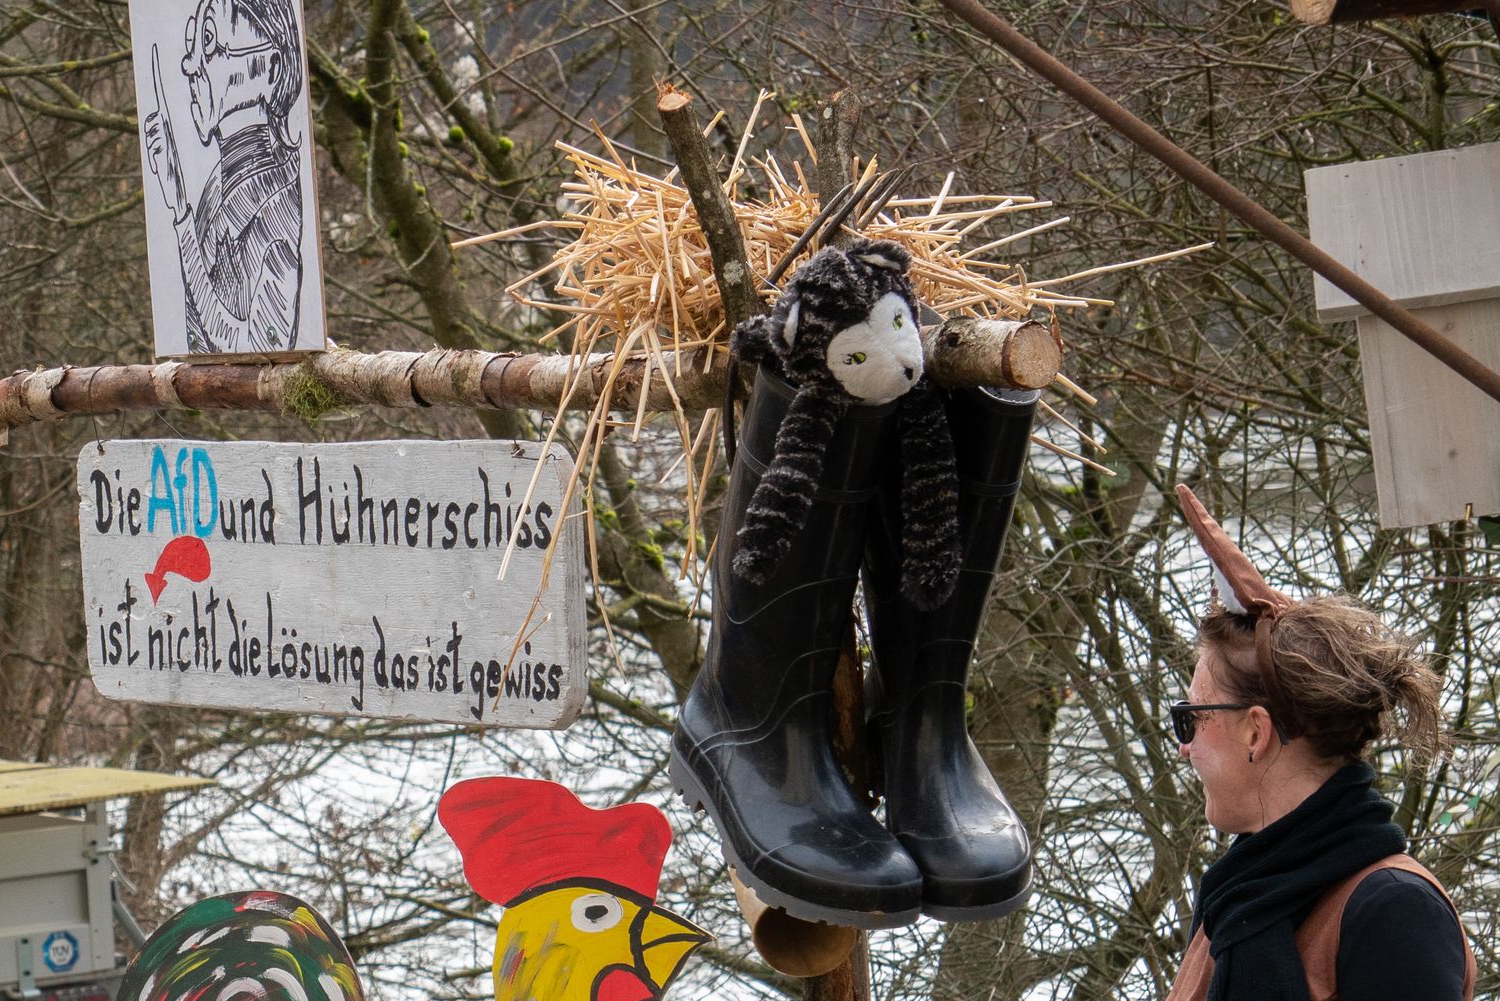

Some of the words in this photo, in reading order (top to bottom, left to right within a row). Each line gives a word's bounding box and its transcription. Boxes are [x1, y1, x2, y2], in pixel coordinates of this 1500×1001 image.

[89, 469, 142, 536] Die
[147, 443, 218, 538] AfD
[219, 468, 276, 545] und
[297, 456, 553, 550] Hühnerschiss
[98, 578, 140, 667] ist
[148, 586, 222, 673] nicht
[226, 598, 262, 678] die
[266, 591, 365, 712] Lösung
[373, 615, 419, 693] das
[425, 621, 465, 694] ist
[469, 641, 564, 721] gewiss
